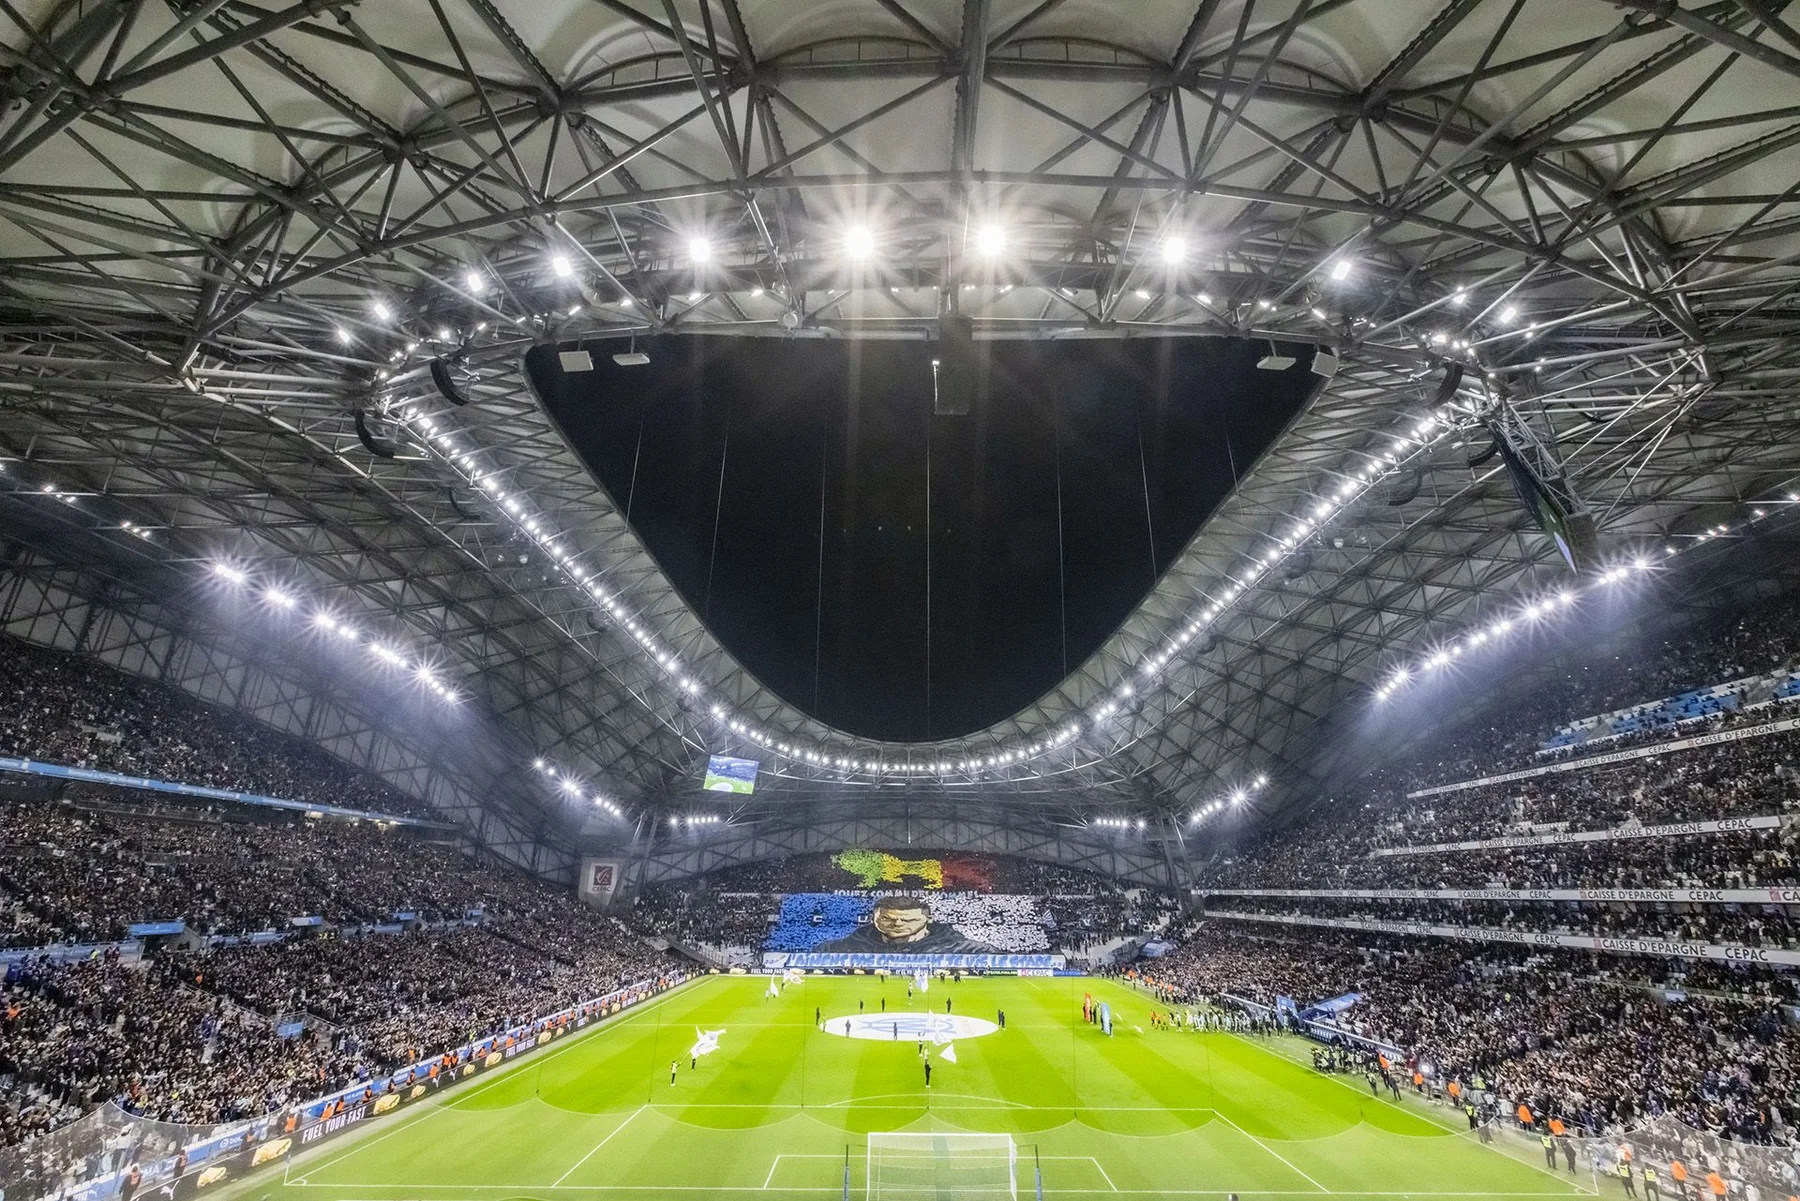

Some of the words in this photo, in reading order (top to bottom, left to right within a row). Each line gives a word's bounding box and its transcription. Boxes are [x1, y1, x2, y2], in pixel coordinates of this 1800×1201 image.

[1694, 735, 1721, 746] CAISSE
[1723, 723, 1780, 742] D'EPARGNE
[1579, 757, 1600, 767] CAISSE
[1650, 743, 1671, 754] CEPAC
[1613, 827, 1643, 838] CAISSE
[1645, 823, 1704, 838] D'EPARGNE
[1717, 818, 1753, 831] CEPAC
[1484, 837, 1504, 848] CAISSE
[1506, 835, 1543, 847] D'EPARGNE
[1553, 833, 1576, 843] CEPAC
[1463, 890, 1483, 898] CAISSE
[1484, 890, 1521, 899] D'EPARGNE
[1529, 890, 1552, 899] CEPAC
[1587, 890, 1616, 900] CAISSE
[1618, 890, 1675, 900] D'EPARGNE
[1688, 890, 1724, 901] CEPAC
[1459, 929, 1480, 939] CAISSE
[1482, 930, 1525, 942] D'EPARGNE
[1534, 934, 1560, 945] CEPAC
[1602, 939, 1636, 951] CAISSE
[1639, 940, 1707, 957] D'EPARGNE
[1725, 947, 1768, 961] CEPAC
[303, 1124, 322, 1144] FUEL
[326, 1115, 346, 1134] YOUR
[347, 1107, 366, 1123] FAST
